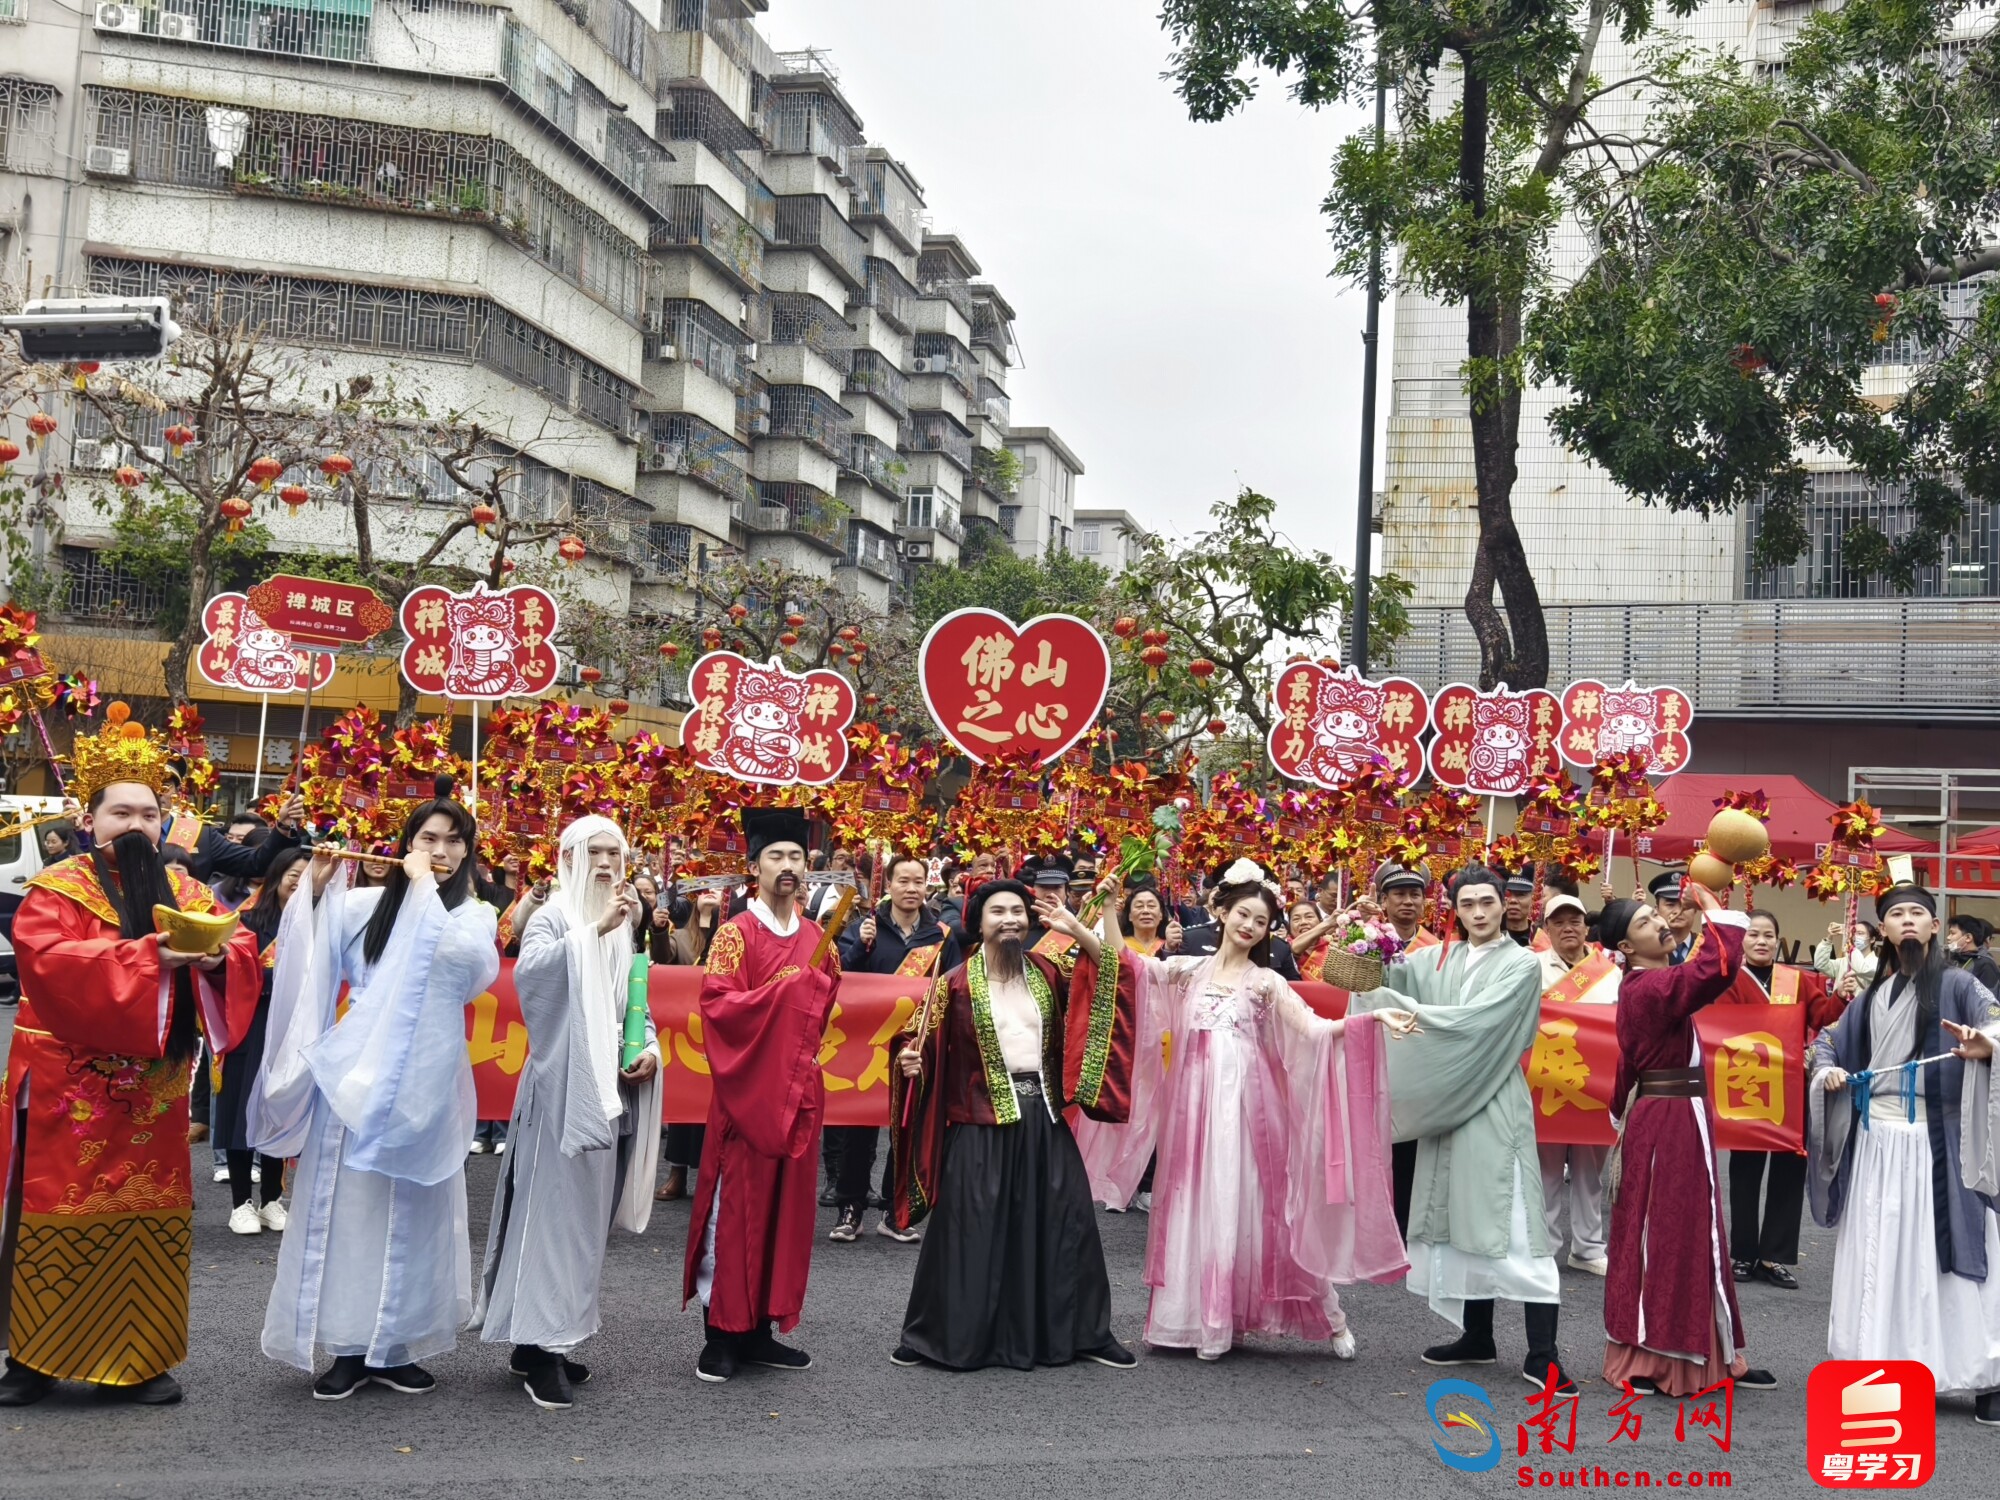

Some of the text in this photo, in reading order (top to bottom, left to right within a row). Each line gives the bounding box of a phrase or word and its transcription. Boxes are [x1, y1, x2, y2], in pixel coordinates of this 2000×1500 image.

[209, 600, 237, 671] 最佛山
[286, 591, 355, 617] 禅城区
[414, 598, 446, 681] 禅城
[518, 596, 546, 678] 最中心
[960, 631, 1068, 693] 佛山
[692, 661, 731, 755] 最便捷
[796, 683, 840, 773] 禅城
[957, 689, 1069, 743] 之心
[1280, 671, 1312, 763] 最活力
[1440, 696, 1471, 776] 禅城
[1568, 689, 1599, 756] 禅城
[1657, 693, 1682, 766] 最平安
[1526, 1017, 1608, 1117] 展
[1714, 1031, 1785, 1126] 图
